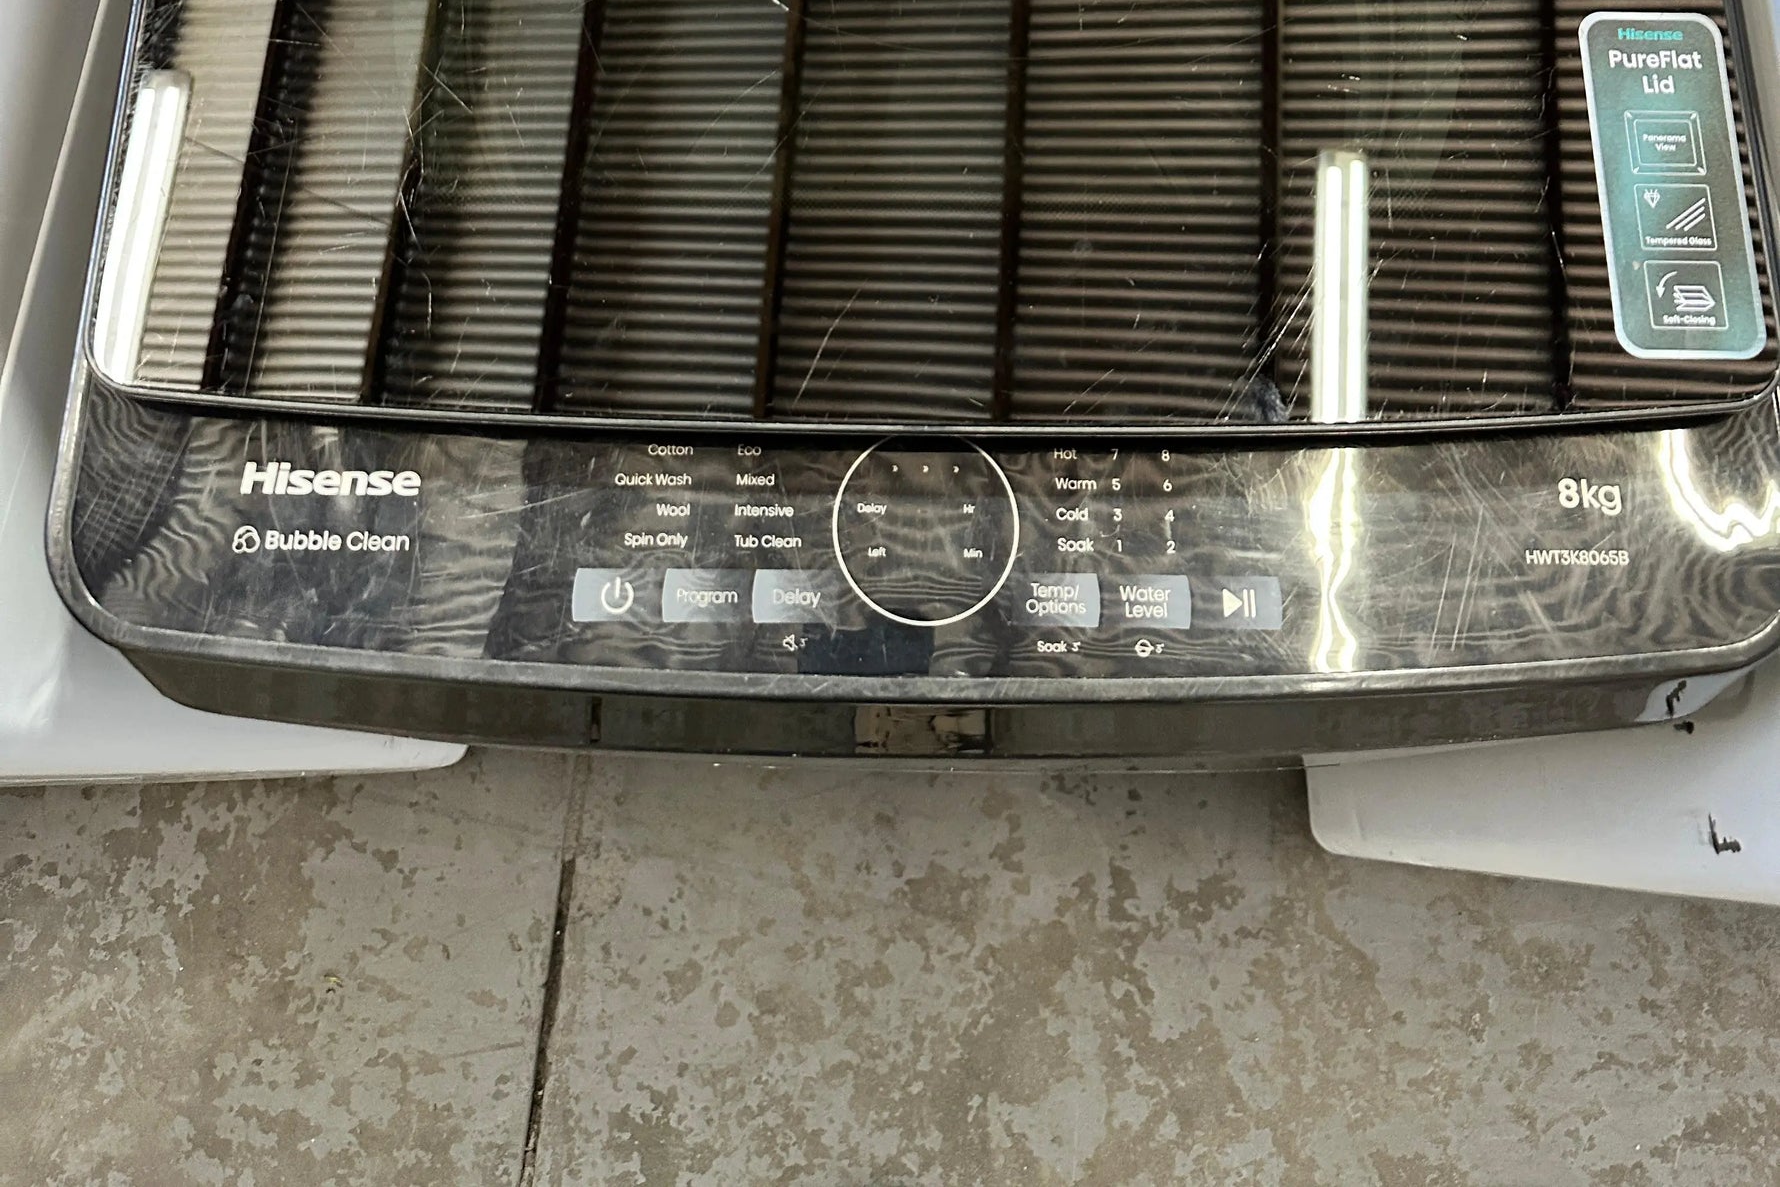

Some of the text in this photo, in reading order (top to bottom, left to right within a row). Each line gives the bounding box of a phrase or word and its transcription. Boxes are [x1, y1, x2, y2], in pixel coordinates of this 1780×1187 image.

[1617, 27, 1684, 42] Hisense
[1608, 49, 1703, 70] PureFlat
[1642, 75, 1675, 95] Lid
[1642, 133, 1687, 144] Panorama
[1655, 142, 1677, 152] View
[1688, 236, 1713, 247] Glass
[648, 443, 694, 456] Cotton
[737, 444, 762, 456] Eco
[1053, 448, 1078, 460] Hot
[1111, 449, 1119, 460] 7
[1161, 450, 1170, 462] 8
[240, 461, 421, 496] Hisense
[614, 473, 692, 487] Quick Wash
[736, 474, 775, 486] Mixed
[1055, 478, 1097, 490] Warm
[1112, 479, 1121, 490] 5
[1163, 480, 1173, 492] 6
[1557, 477, 1623, 516] 8kg
[656, 504, 691, 516] Wool
[734, 504, 794, 517] Intensive
[857, 502, 887, 515] Delay
[963, 504, 976, 514] Hr
[1056, 507, 1089, 521] Cold
[1113, 508, 1123, 521] 3
[1164, 509, 1175, 522] 4
[264, 530, 410, 551] Bubble Clean
[624, 533, 688, 548] Spin Only
[734, 535, 802, 549] Tub Clean
[1057, 538, 1095, 552] Soak
[1116, 540, 1123, 552] 1
[1166, 541, 1176, 553] 2
[868, 546, 887, 557] Left
[964, 547, 983, 558] Min
[676, 588, 738, 605] Program
[1030, 582, 1080, 599] Temp/
[1119, 586, 1171, 601] Water
[772, 588, 821, 607] Delay
[1025, 598, 1087, 616] Options
[1125, 603, 1168, 618] Level
[1037, 640, 1067, 653] Soak
